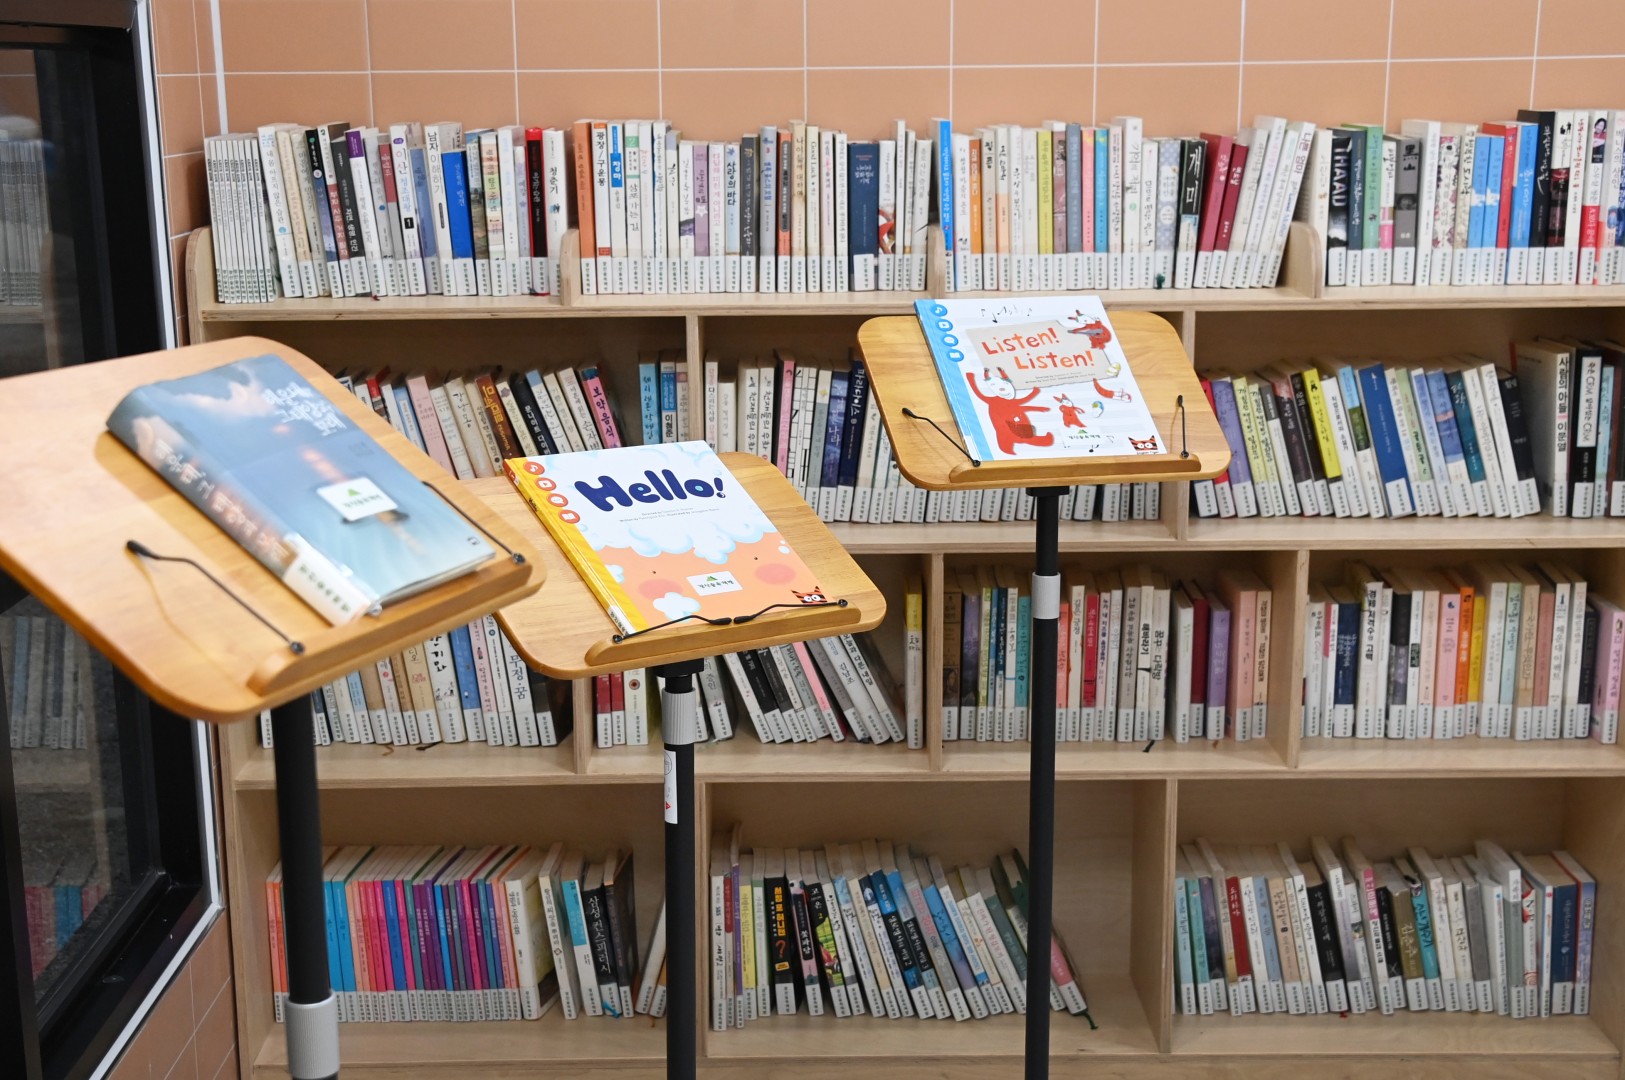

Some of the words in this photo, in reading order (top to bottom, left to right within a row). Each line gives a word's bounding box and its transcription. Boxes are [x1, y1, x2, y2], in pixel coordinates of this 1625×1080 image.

[428, 132, 439, 152] 남자
[430, 154, 444, 193] 이해하기
[612, 160, 622, 180] 장마
[726, 162, 736, 190] 사랑의
[1295, 155, 1307, 174] 엄마
[628, 184, 638, 199] 삼포
[1185, 145, 1202, 213] 개미
[629, 202, 639, 219] 가는
[727, 191, 736, 207] 바다
[981, 327, 1060, 356] Listen!
[1014, 350, 1096, 371] Listen!
[1557, 356, 1569, 391] 사람의
[850, 368, 866, 417] 파라다이스
[1557, 392, 1568, 414] 아들
[1557, 422, 1568, 453] 이문열
[574, 469, 726, 512] Hello!
[1151, 654, 1163, 680] 다락방
[588, 896, 601, 918] 삼성
[592, 920, 611, 975] 컨스피러시
